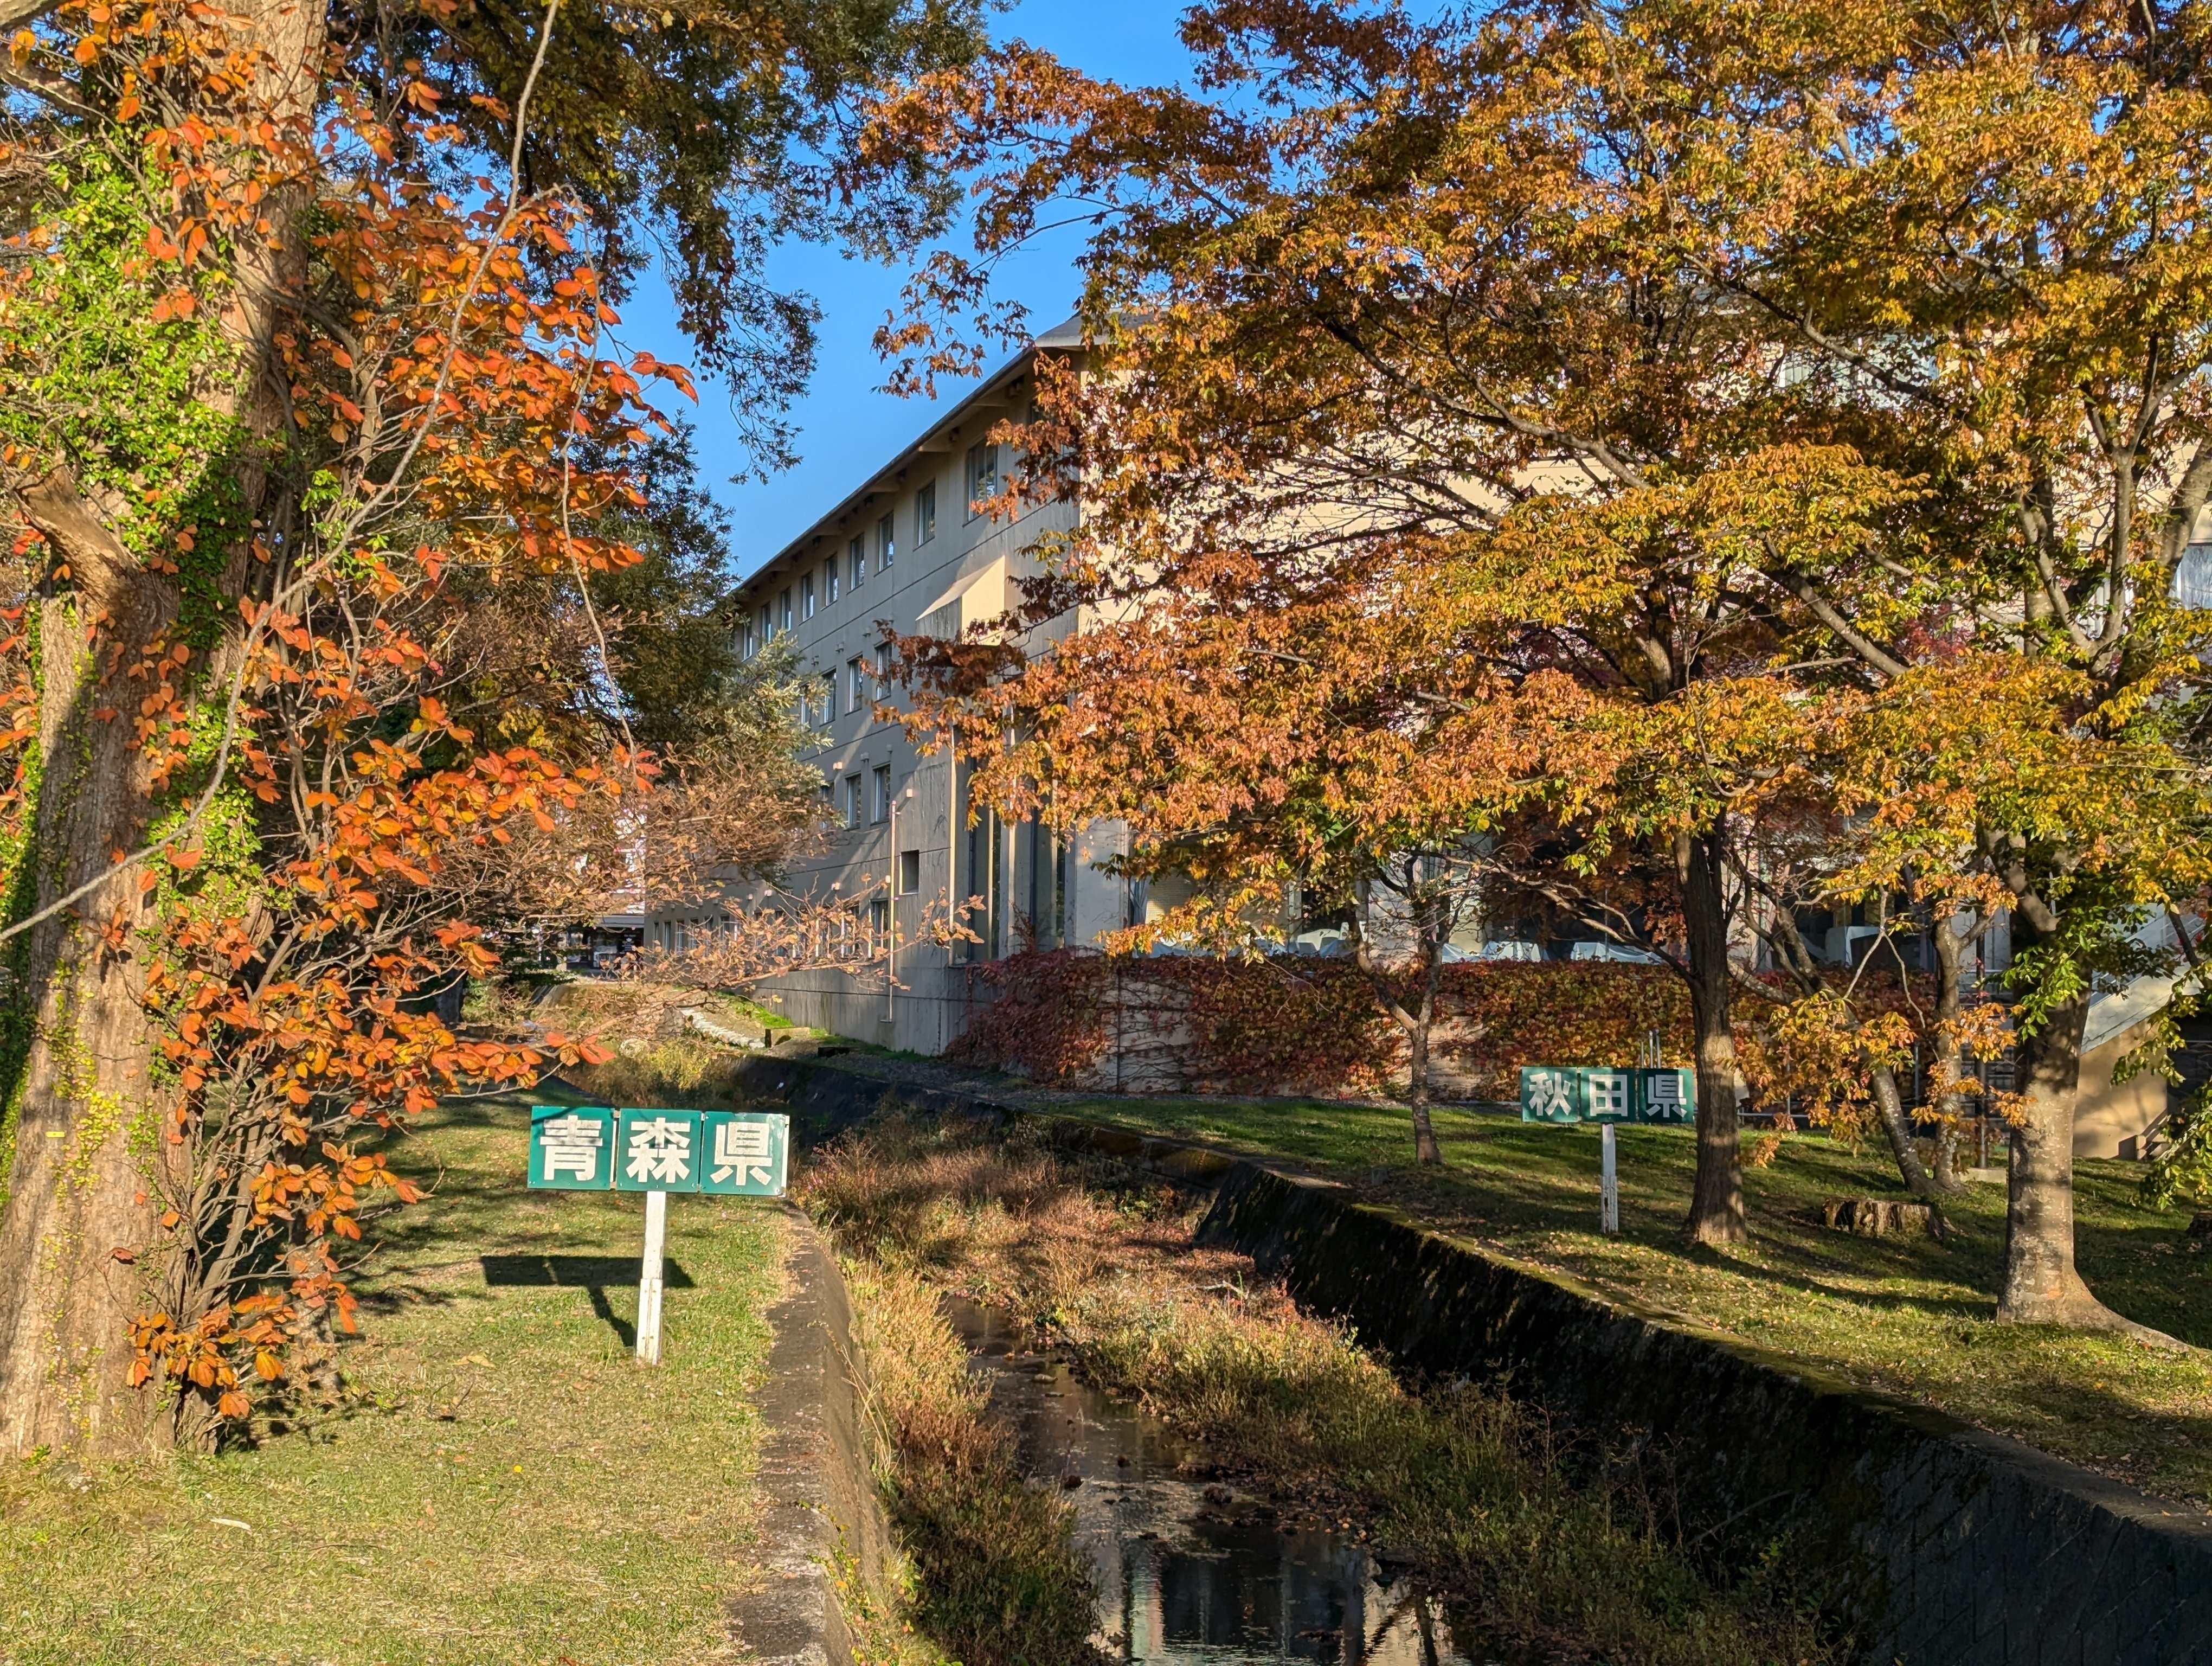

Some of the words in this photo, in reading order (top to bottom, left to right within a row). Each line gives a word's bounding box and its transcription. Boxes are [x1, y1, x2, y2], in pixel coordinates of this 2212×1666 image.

[1528, 1072, 1687, 1118] 秋田県
[540, 1115, 772, 1186] 青森県
